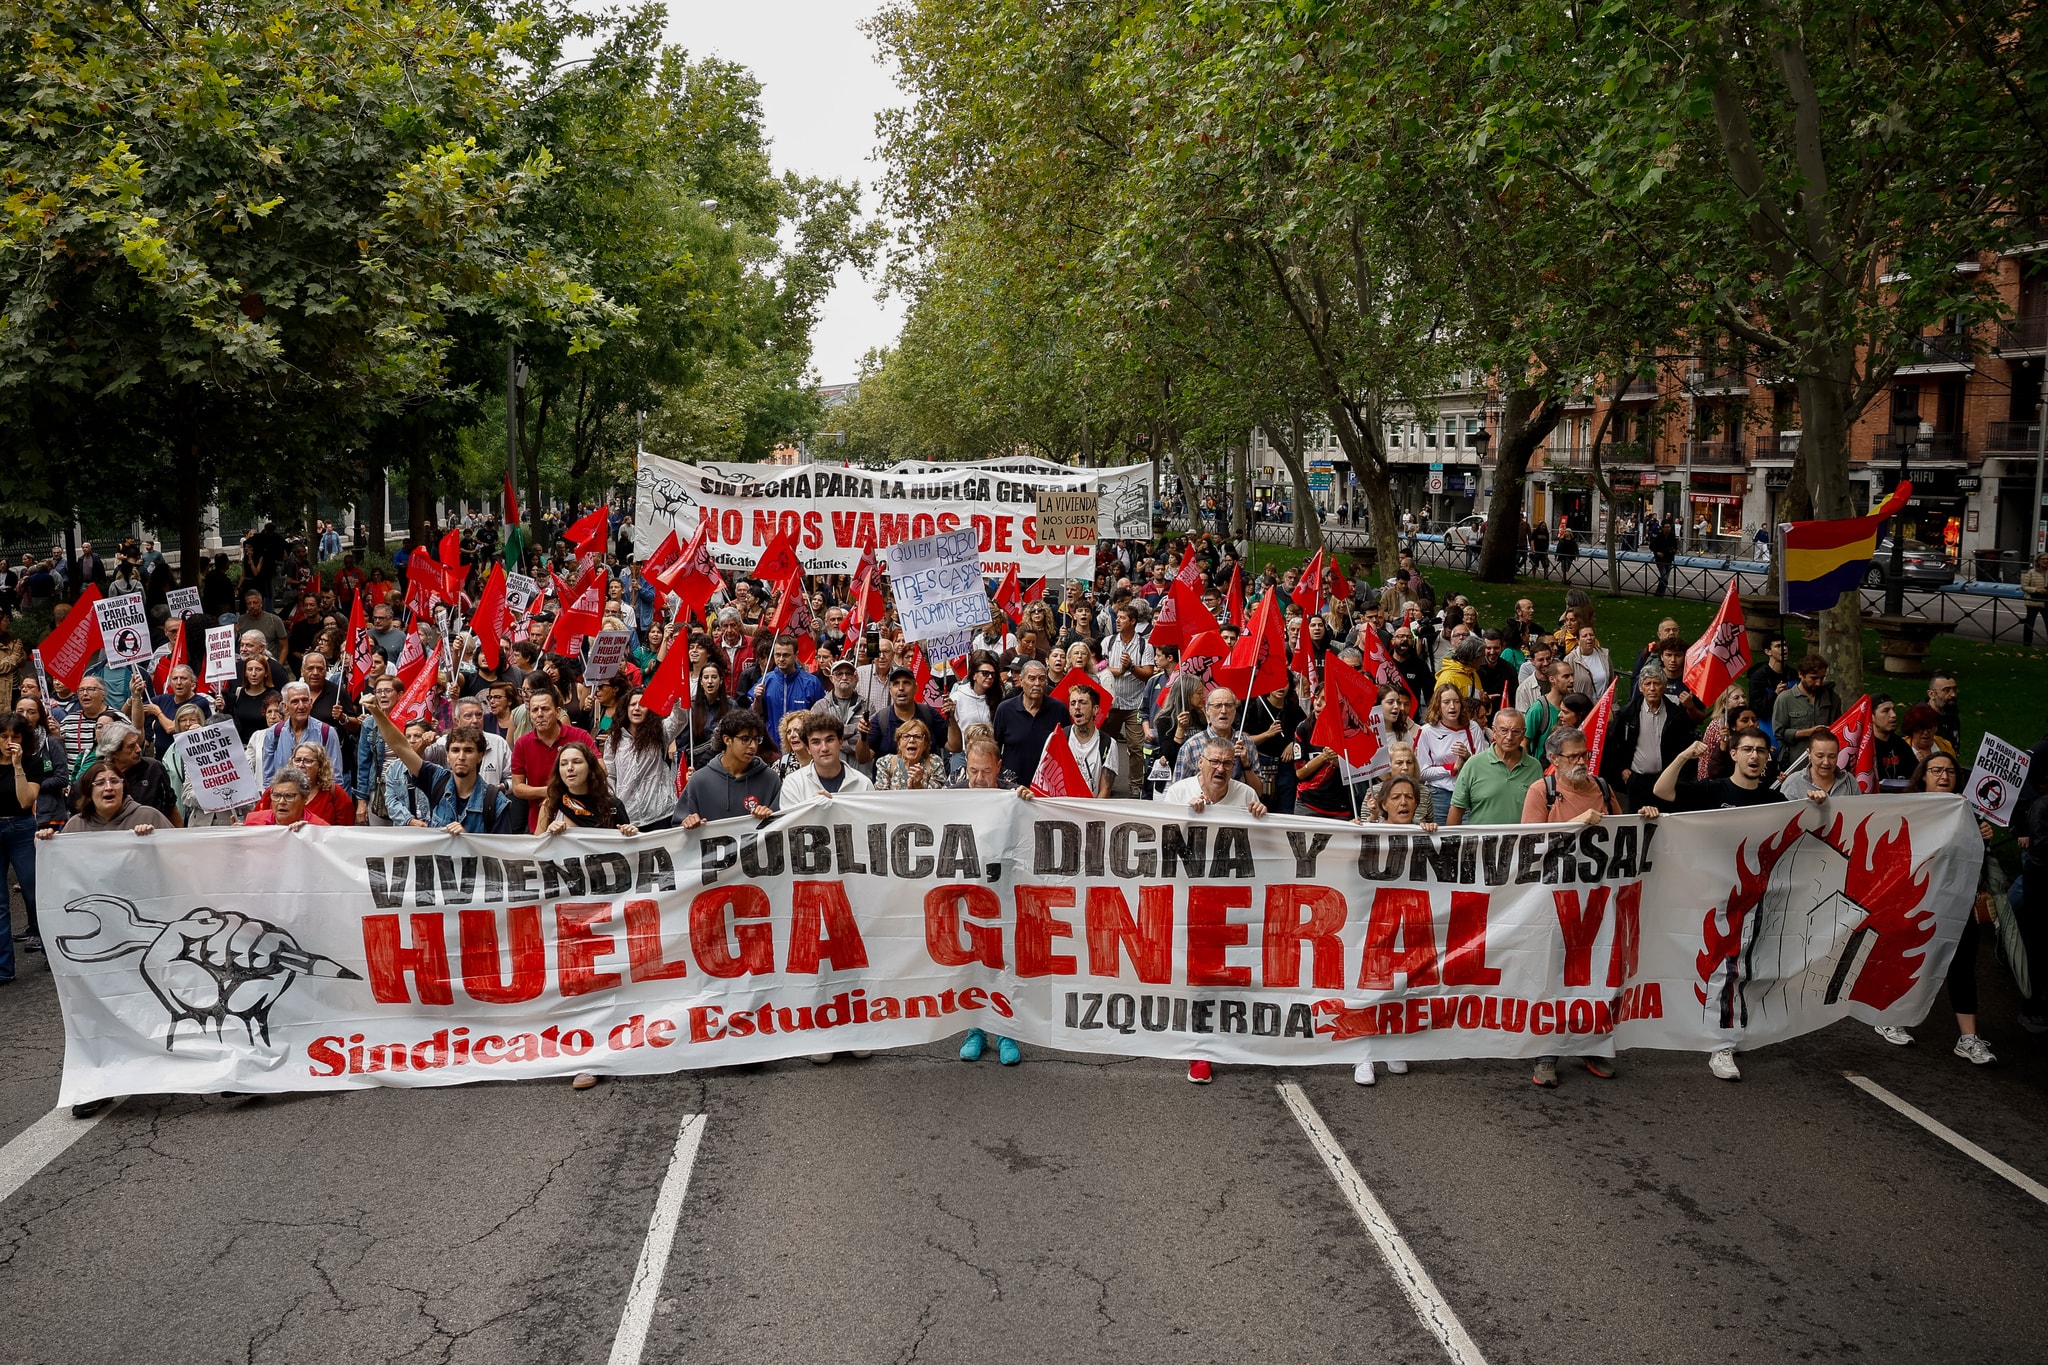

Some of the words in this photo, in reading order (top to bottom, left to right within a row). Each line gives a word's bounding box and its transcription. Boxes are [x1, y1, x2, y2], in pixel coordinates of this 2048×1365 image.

[1909, 470, 1934, 483] SHIFU
[700, 476, 737, 497] SIN
[814, 472, 875, 499] PARA
[880, 480, 907, 499] LA
[911, 478, 990, 502] HUELGA
[1038, 496, 1053, 513] LA
[1055, 496, 1098, 512] VIVIENDA
[1043, 516, 1063, 525] NOS
[1064, 515, 1096, 525] CUESTA
[699, 506, 743, 547] NO
[753, 509, 824, 550] NOS
[972, 514, 1014, 553] DE
[1042, 528, 1056, 541] LA
[1065, 526, 1096, 541] VIDA
[891, 541, 932, 563] QUIEN
[712, 553, 757, 567] dicato
[800, 558, 848, 571] diantes
[892, 569, 936, 601] TRES
[938, 560, 981, 589] CASAS
[952, 580, 975, 596] EN
[96, 604, 106, 612] NO
[129, 596, 142, 604] PAZ
[170, 600, 200, 611] RENTISMO
[172, 596, 188, 604] PARA
[104, 607, 128, 620] PARA
[129, 604, 138, 615] EL
[101, 614, 144, 632] RENTISMO
[210, 640, 230, 652] HUELGA
[210, 650, 232, 662] GENERAL
[187, 732, 200, 744] NO
[202, 728, 221, 742] NOS
[186, 741, 218, 758] VAMOS
[220, 736, 232, 748] DE
[1984, 736, 1995, 747] NO
[2017, 754, 2028, 768] PAZ
[196, 754, 213, 767] SOL
[215, 748, 230, 760] SIN
[1986, 748, 2011, 770] PARA
[2012, 764, 2022, 776] EL
[200, 760, 234, 778] HUELGA
[1977, 756, 2022, 788] RENTISMO
[202, 770, 240, 790] GENERAL
[366, 846, 676, 908] VIVIENDA
[1034, 820, 1255, 879] DIGNA
[1286, 832, 1334, 879] Y
[1358, 823, 1658, 886] UNIVERSAL
[361, 880, 870, 1005] HUELGA
[924, 884, 1502, 991] GENERAL
[1552, 880, 1642, 987] YA
[1065, 992, 1314, 1038] IZQUIERDA
[307, 1026, 595, 1077] Sindicato
[608, 1014, 677, 1050] de
[688, 986, 1014, 1045] Estudiantes
